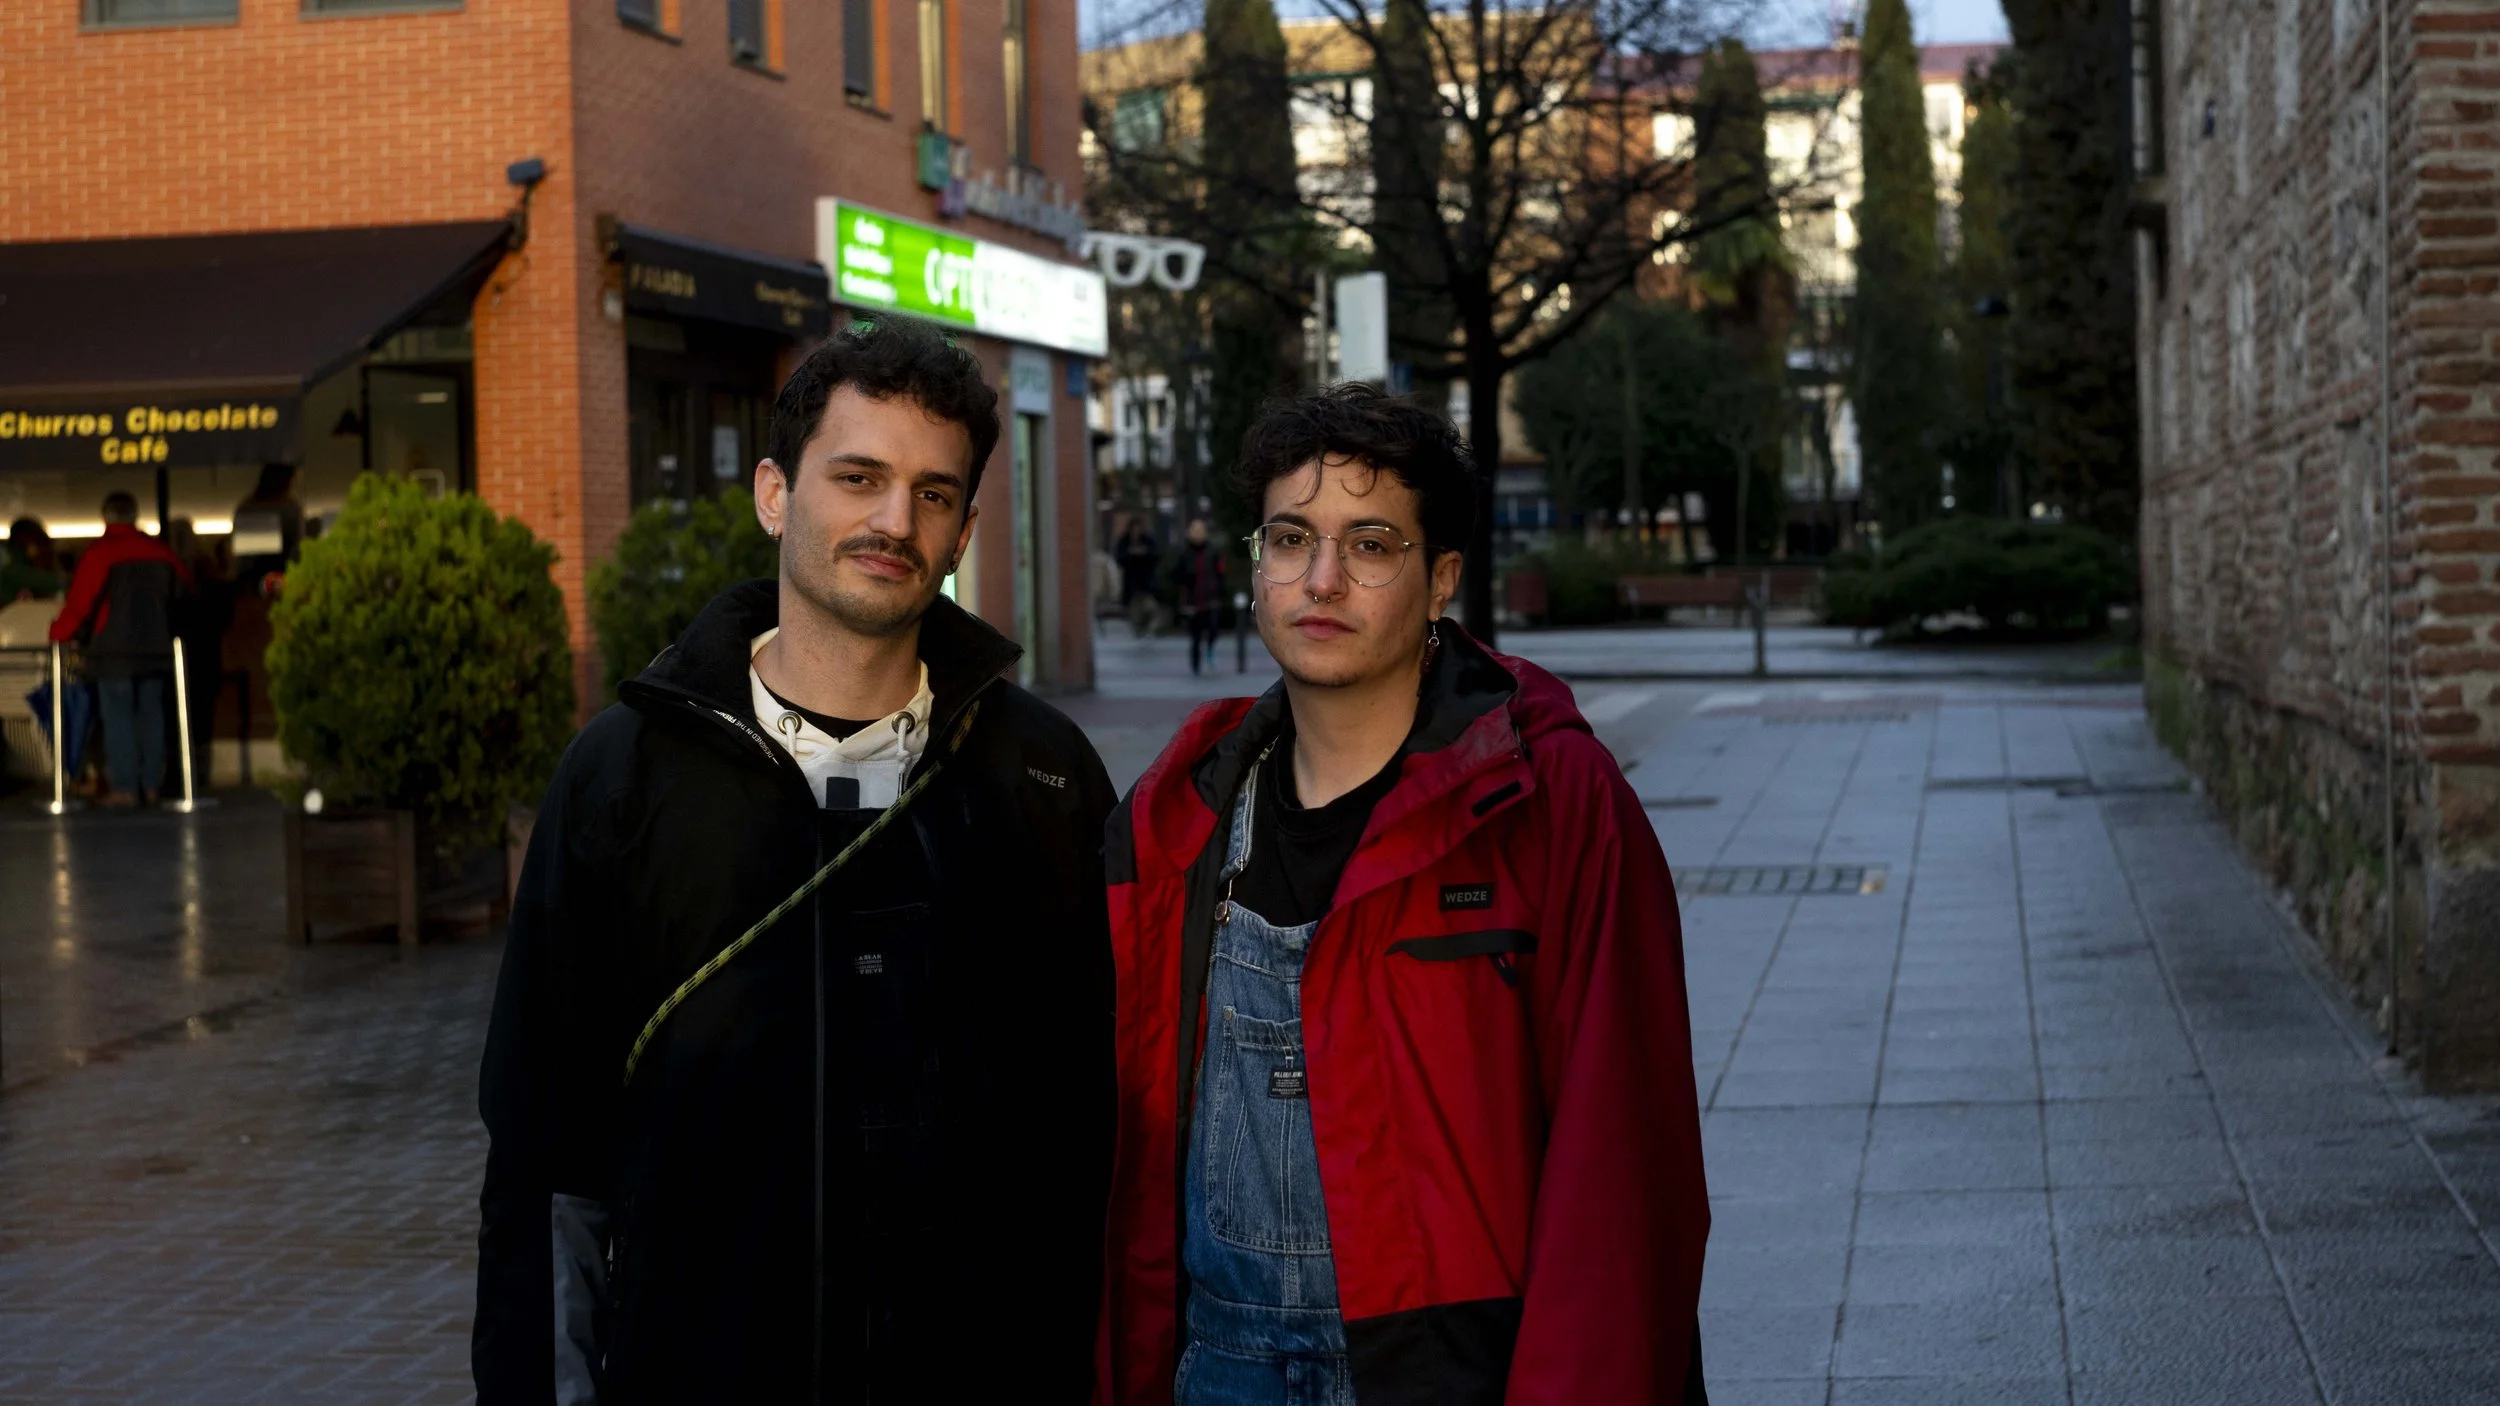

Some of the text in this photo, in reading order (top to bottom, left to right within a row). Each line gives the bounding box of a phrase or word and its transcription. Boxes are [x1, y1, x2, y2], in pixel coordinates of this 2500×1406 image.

[0, 403, 279, 439] Churros Chocolate
[101, 435, 169, 464] Café
[735, 720, 747, 731] THE
[745, 728, 753, 736] IN
[751, 732, 774, 758] DESIGNED
[1026, 766, 1066, 788] WEDZE
[1445, 891, 1488, 903] WEDZE
